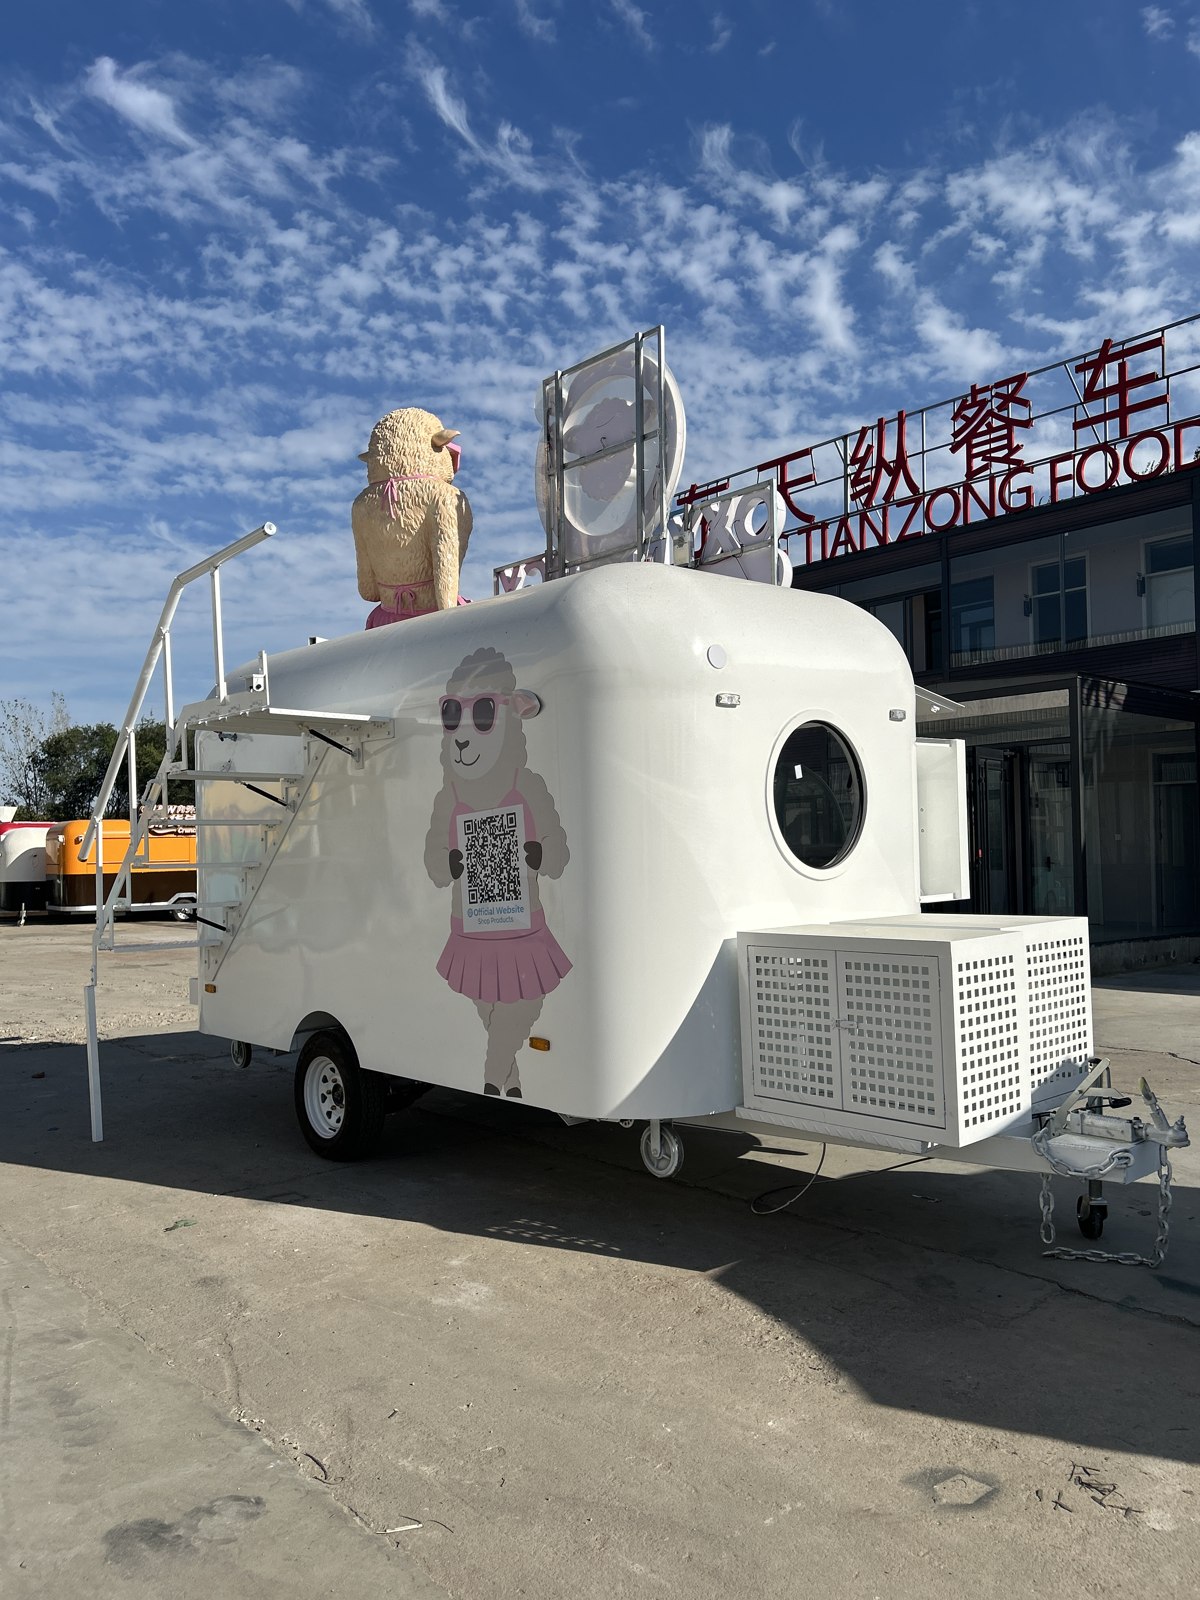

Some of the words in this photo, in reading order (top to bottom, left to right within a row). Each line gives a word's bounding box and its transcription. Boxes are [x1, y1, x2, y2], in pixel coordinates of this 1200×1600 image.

[797, 466, 1034, 565] TIANZONG
[473, 906, 495, 917] Official
[495, 904, 524, 915] Website
[477, 917, 490, 925] Shop
[490, 915, 514, 924] Products
